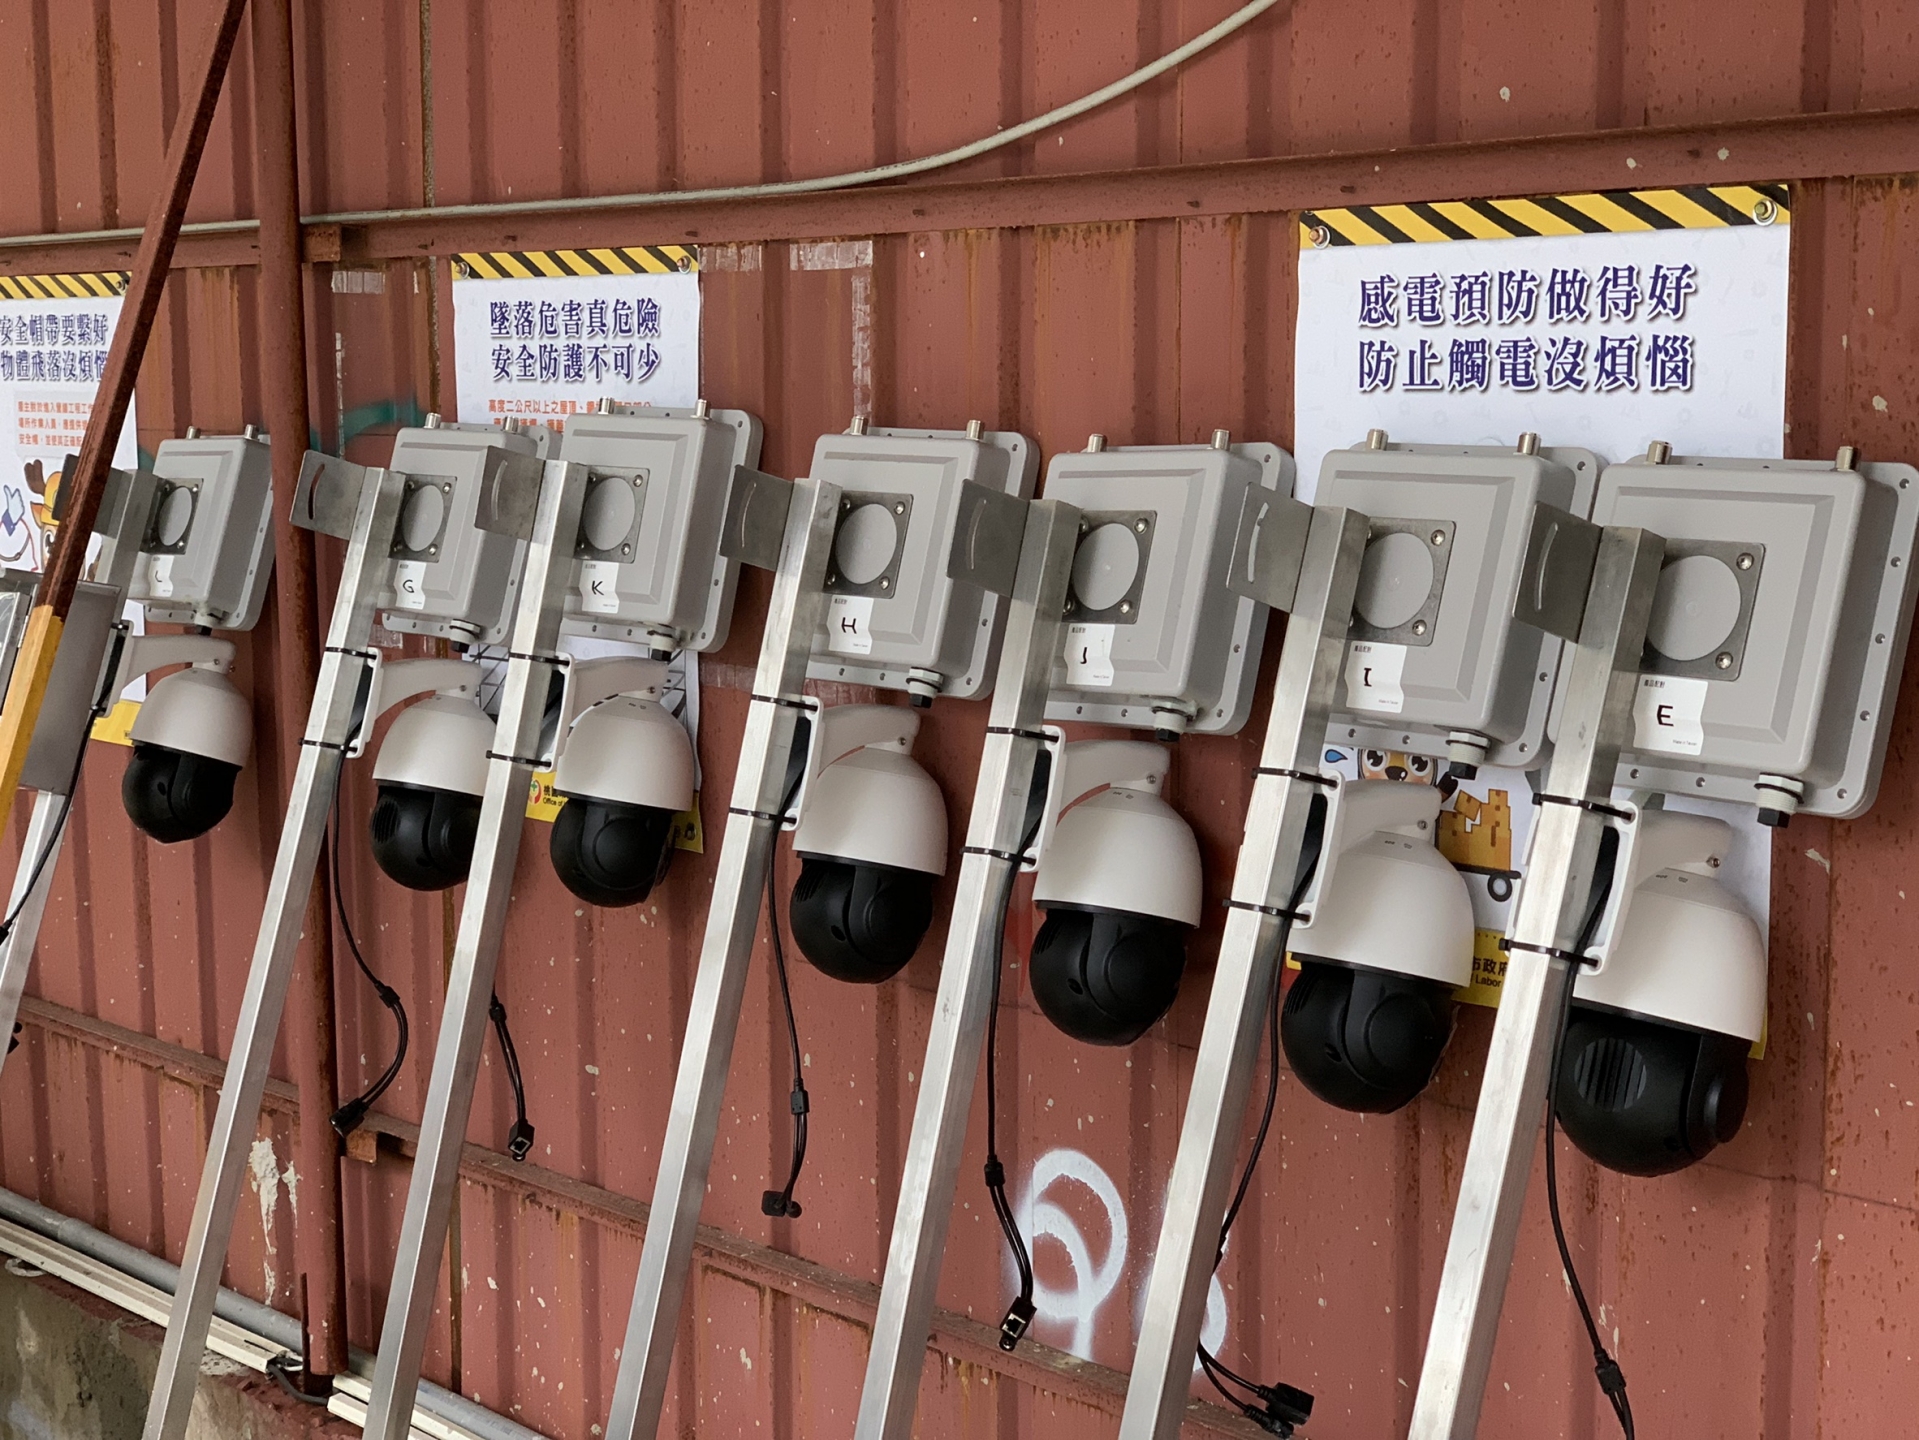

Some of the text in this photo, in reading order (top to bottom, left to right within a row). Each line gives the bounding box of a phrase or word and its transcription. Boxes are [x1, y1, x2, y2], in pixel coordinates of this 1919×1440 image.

[1358, 263, 1696, 327] 感電預防做得好
[0, 314, 108, 344] 安全帽帶要繫好
[490, 298, 660, 337] 墜落危害真危險
[491, 343, 661, 380] 安全防護不可少
[1358, 334, 1695, 392] 防止觸電沒煩惱
[402, 579, 415, 593] G
[591, 580, 605, 596] K
[841, 616, 857, 634] H
[1080, 646, 1088, 665] J
[1656, 704, 1674, 727] E
[1475, 974, 1501, 988] Labor
